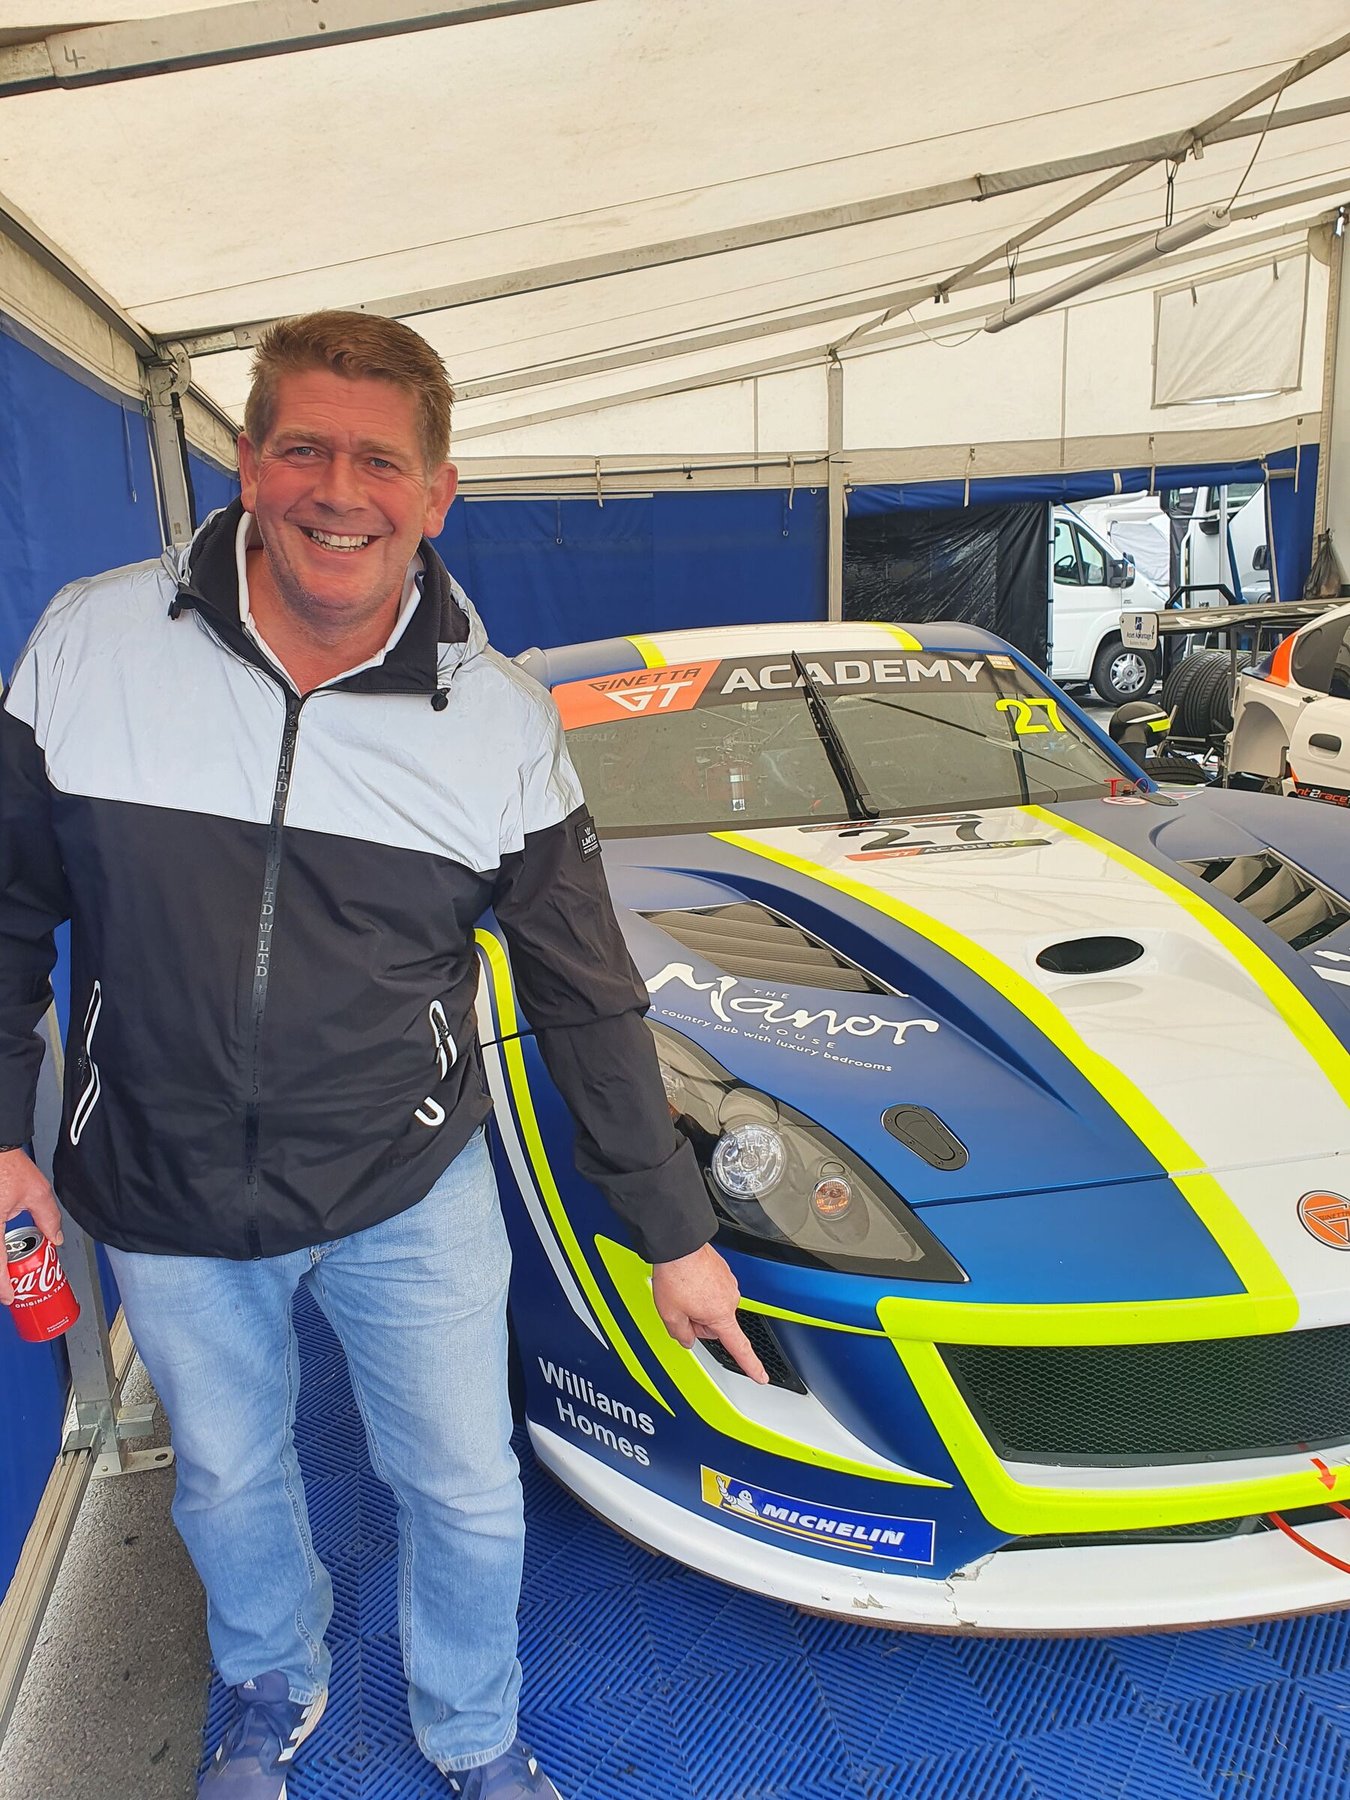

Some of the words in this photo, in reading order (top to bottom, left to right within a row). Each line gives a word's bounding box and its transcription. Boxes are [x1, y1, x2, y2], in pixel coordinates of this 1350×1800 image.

[64, 45, 86, 69] 4
[588, 668, 702, 692] GINETTA
[720, 659, 985, 695] ACADEMY
[604, 681, 693, 712] GT
[995, 698, 1067, 735] 27
[838, 821, 985, 851] 27
[923, 841, 1018, 853] ACADEMY
[256, 940, 269, 977] LTD
[644, 963, 939, 1045] Manor
[752, 988, 791, 1000] THE
[661, 1009, 712, 1028] country
[713, 1024, 739, 1034] pub
[743, 1031, 771, 1043] with
[776, 1039, 819, 1056] luxury
[824, 1052, 892, 1072] bedrooms
[759, 1023, 836, 1049] HOUSE
[15, 1293, 53, 1309] ORIGINAL
[538, 1356, 656, 1435] Williams
[556, 1396, 650, 1466] Homes
[762, 1503, 905, 1545] MICHELIN
